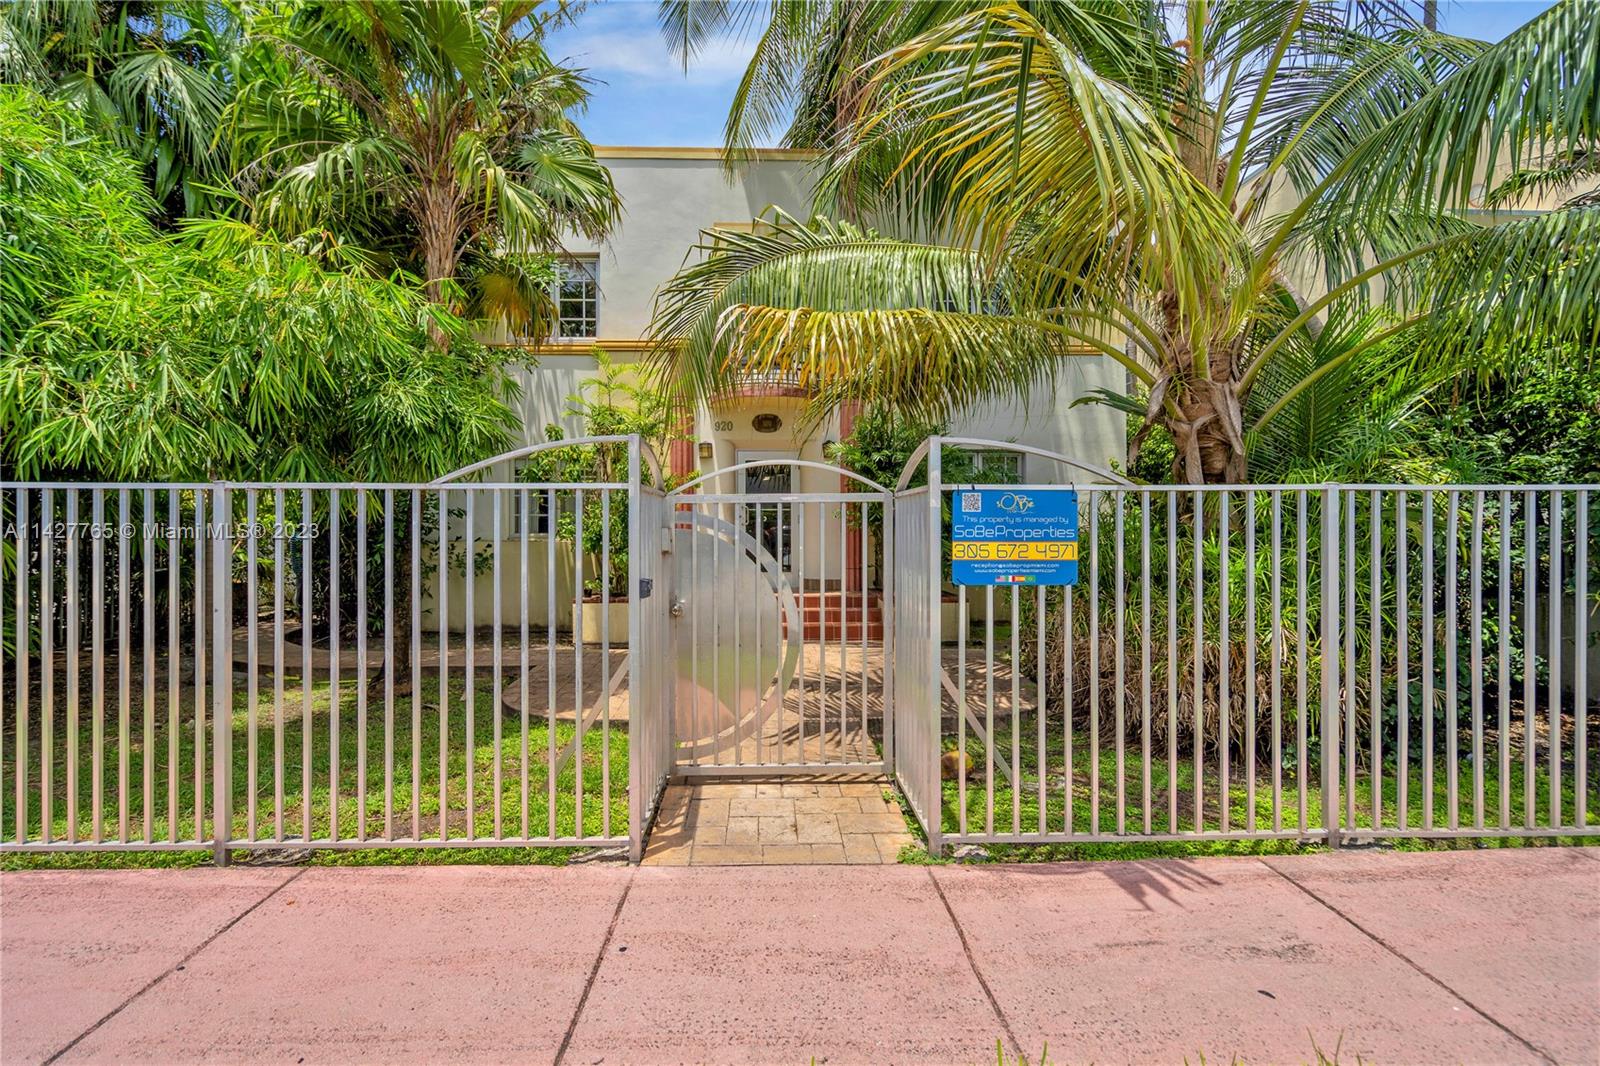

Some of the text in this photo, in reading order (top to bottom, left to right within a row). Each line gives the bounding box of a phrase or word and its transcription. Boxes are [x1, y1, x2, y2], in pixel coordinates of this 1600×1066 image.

[714, 421, 734, 432] 920
[962, 515, 978, 523] This
[979, 516, 1014, 525] property
[1023, 516, 1059, 525] managed
[1059, 516, 1069, 525] by
[954, 525, 1075, 541] SoBeProperties
[954, 543, 1075, 559] 305 672 4971
